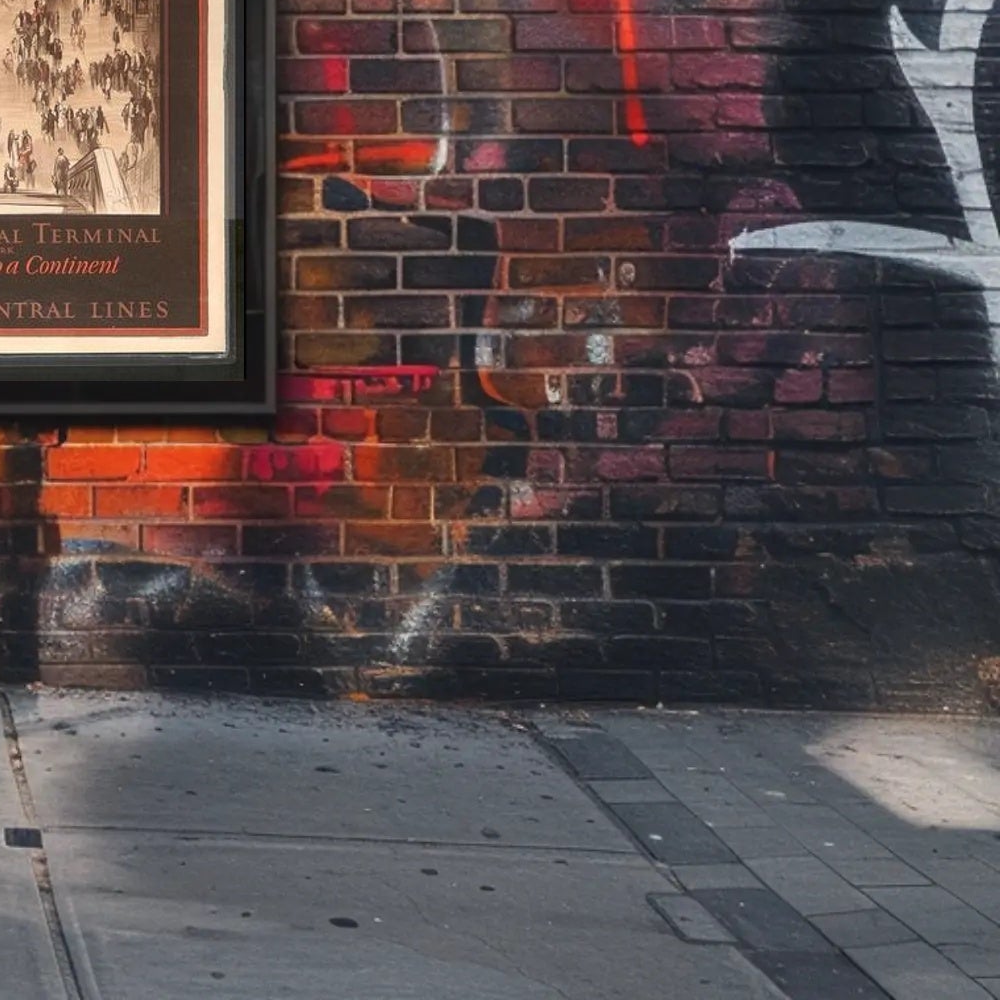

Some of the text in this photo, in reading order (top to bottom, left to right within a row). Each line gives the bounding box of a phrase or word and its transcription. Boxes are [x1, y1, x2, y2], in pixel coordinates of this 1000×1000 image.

[6, 262, 20, 275] a
[26, 254, 120, 275] Continent
[90, 301, 169, 319] LINES
